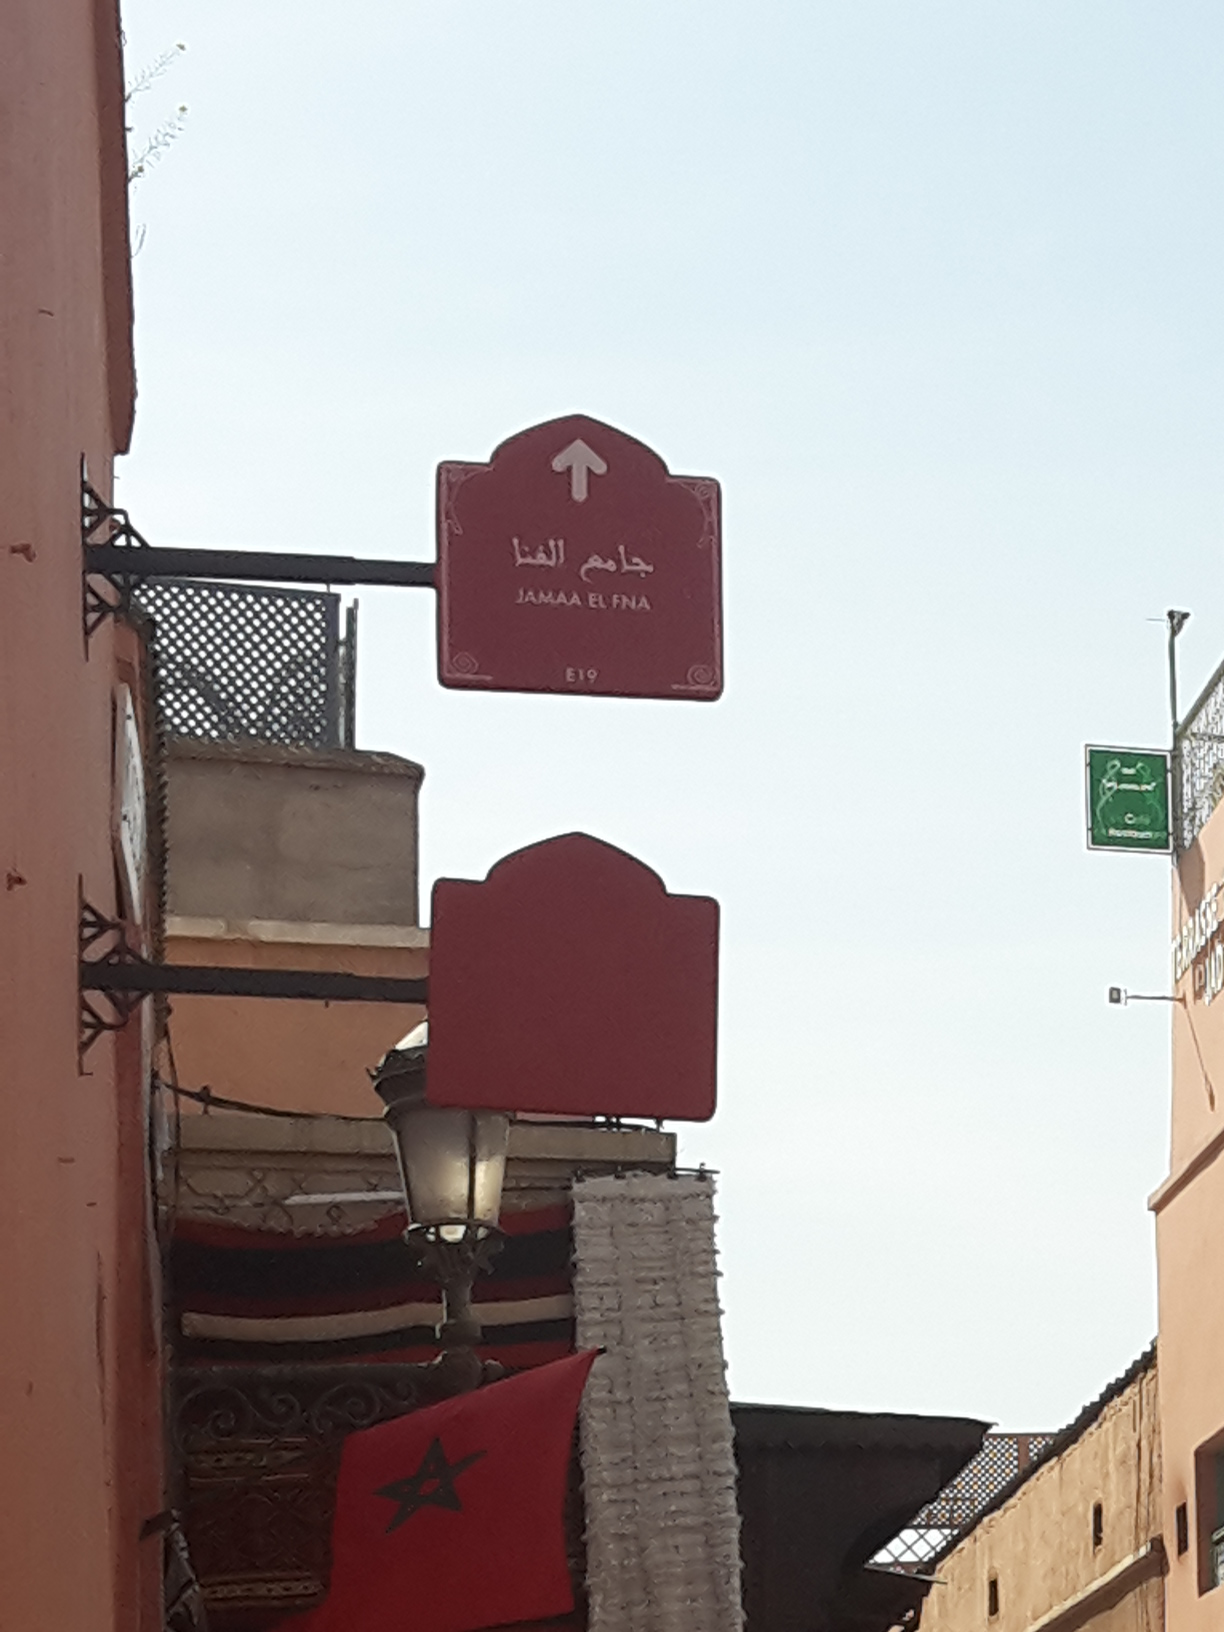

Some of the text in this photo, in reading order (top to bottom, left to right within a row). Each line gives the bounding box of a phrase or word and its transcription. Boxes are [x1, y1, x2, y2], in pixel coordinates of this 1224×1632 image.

[512, 537, 565, 567] الفنا
[516, 587, 651, 611] JAMAA EL FNA
[565, 667, 599, 683] E19
